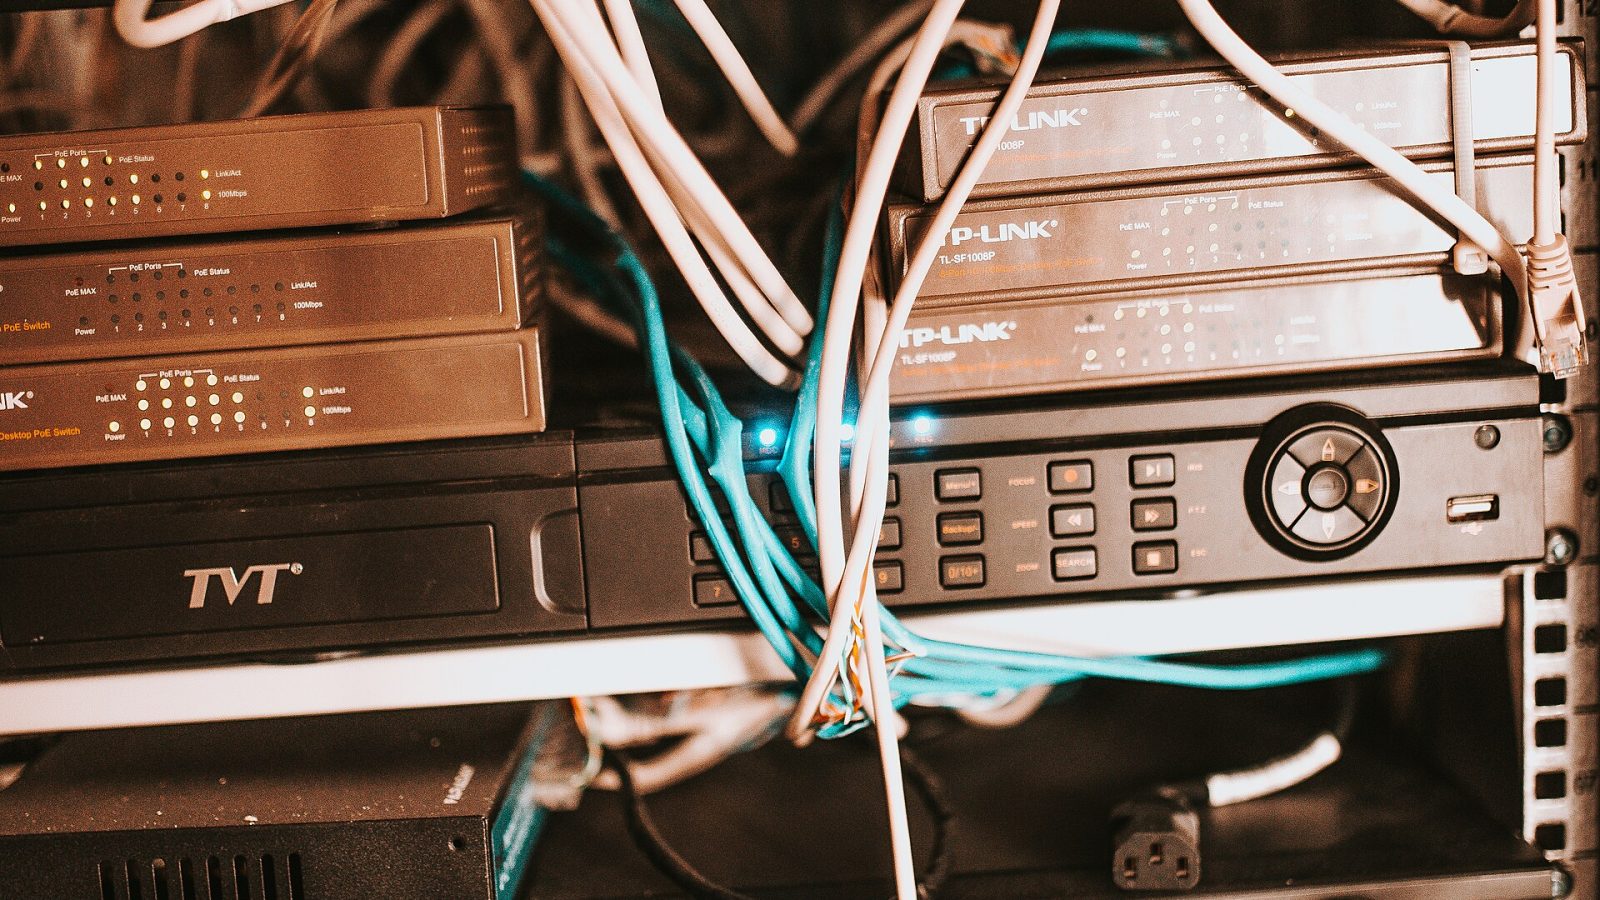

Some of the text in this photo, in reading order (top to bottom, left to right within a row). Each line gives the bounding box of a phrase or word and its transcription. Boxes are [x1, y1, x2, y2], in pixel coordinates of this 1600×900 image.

[960, 108, 1081, 135] TLINK
[218, 190, 248, 198] 100Mbps
[939, 251, 996, 264] TL-SF1008P
[210, 268, 230, 276] Status
[291, 282, 317, 290] Link/Act
[294, 301, 322, 309] 100Mbps
[4, 321, 50, 332] PoE Switch
[899, 321, 1011, 348] TP-LINK
[174, 370, 192, 378] Ports
[239, 374, 260, 382] Status
[320, 387, 346, 396] Link/Act
[322, 406, 352, 414] 100Mbps
[0, 427, 80, 440] Desktop PoE Switch
[792, 536, 800, 548] 5
[1056, 558, 1093, 568] SEARCH
[878, 570, 888, 584] 9
[184, 563, 290, 608] TVT
